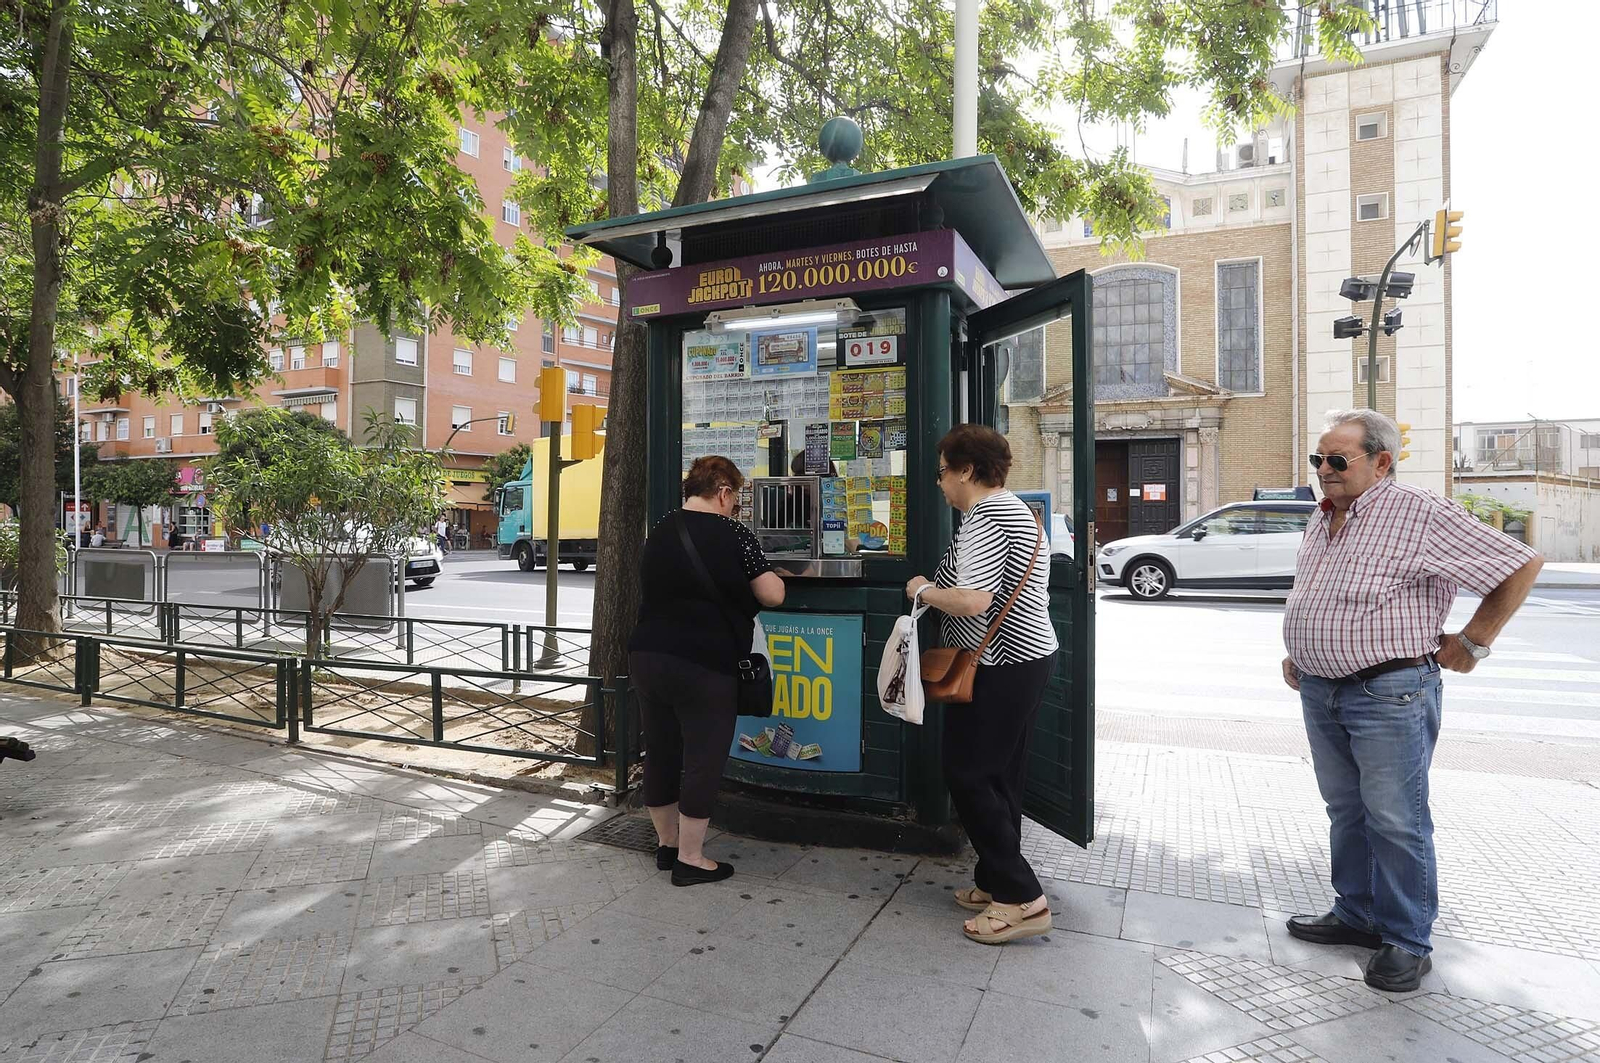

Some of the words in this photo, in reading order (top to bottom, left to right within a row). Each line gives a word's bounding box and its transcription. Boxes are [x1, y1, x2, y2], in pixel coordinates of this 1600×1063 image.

[758, 260, 784, 273] AHORA,
[786, 255, 813, 269] MARTES
[815, 254, 820, 265] Y
[821, 250, 855, 264] VIERNES,
[856, 247, 880, 259] BOTES
[881, 244, 892, 256] DE
[893, 241, 918, 254] HASTA
[699, 267, 738, 287] EURO
[758, 255, 919, 294] 120.000.000€
[687, 279, 751, 304] JACKPOT
[453, 470, 476, 479] JUEGOS
[765, 624, 777, 633] QUE
[777, 624, 799, 634] JUGÁIS
[801, 626, 805, 634] A
[807, 626, 815, 635] LA
[816, 627, 834, 636] ONCE
